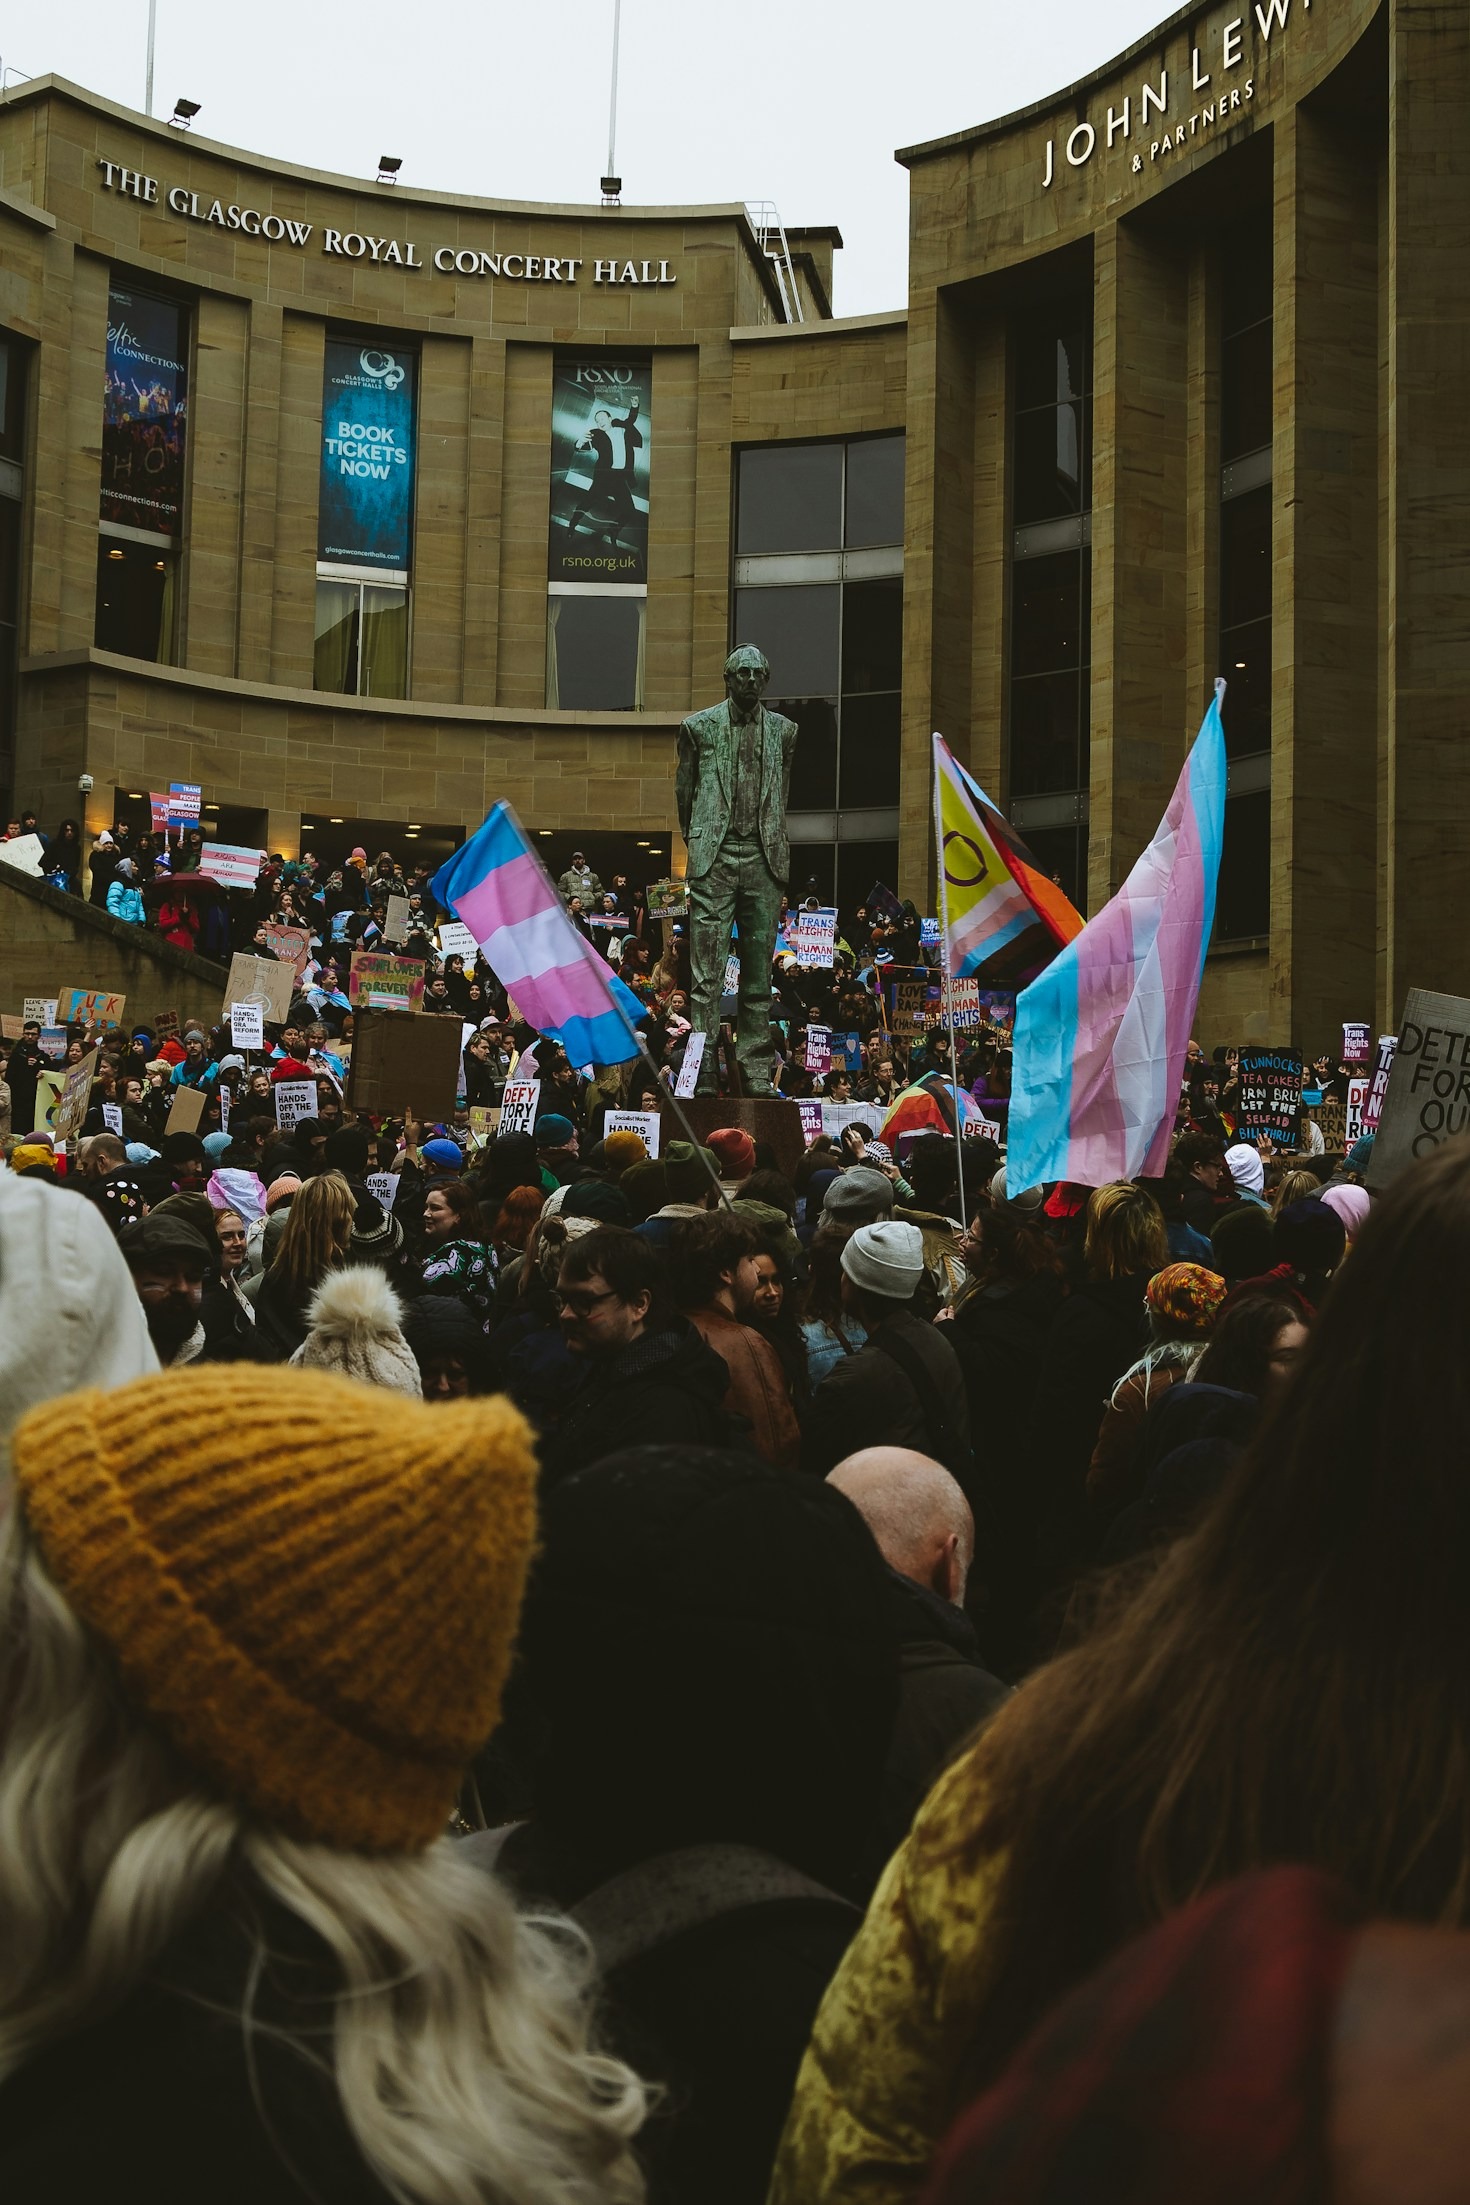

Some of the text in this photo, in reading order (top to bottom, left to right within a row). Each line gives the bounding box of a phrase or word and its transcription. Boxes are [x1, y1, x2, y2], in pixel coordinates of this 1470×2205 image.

[1042, 0, 1311, 187] JOHN LEW
[1131, 79, 1254, 173] & PARTNERS
[99, 159, 676, 283] THE GLASGOW ROYAL CONCERT HALL
[106, 321, 142, 354] eltic
[117, 346, 185, 373] CONNECTIONS
[344, 374, 383, 384] GLASGOW'S
[575, 364, 633, 384] RSNO
[331, 377, 382, 390] CONCERT HALLS
[339, 421, 394, 444] BOOK
[325, 438, 407, 464] TICKETS
[341, 459, 390, 480] NOW
[325, 545, 400, 561] glasgowconcerthalls.com
[562, 555, 636, 572] rsno.org.uk
[169, 810, 200, 818] GLASGOW
[801, 917, 834, 928] TRANS
[799, 926, 834, 937] RIGHTS
[266, 935, 305, 948] ROTECT
[274, 947, 298, 957] RANS
[797, 944, 833, 955] HUMAN
[798, 953, 833, 963] RIGHTS
[898, 983, 928, 998] LOVE
[71, 990, 119, 1014] FUCK
[897, 999, 926, 1012] RAGE
[941, 1009, 980, 1029] RGHTS
[807, 1030, 827, 1043] Trans
[1344, 1028, 1365, 1037] Trans
[807, 1042, 831, 1057] Rights
[1344, 1037, 1369, 1049] Rights
[1344, 1047, 1361, 1057] Now
[806, 1054, 823, 1068] Now
[1240, 1056, 1301, 1075] TUNNOCKS
[1241, 1073, 1300, 1089] TEA CAKES
[1410, 1063, 1470, 1104] FOR
[278, 1094, 307, 1103] HANDS
[504, 1087, 537, 1103] DEFY
[1273, 1087, 1301, 1107] BRU!
[279, 1102, 312, 1111] OFF THE
[503, 1103, 534, 1118] TORY
[799, 1107, 815, 1116] ans
[1240, 1100, 1297, 1115] LET THE
[280, 1112, 296, 1120] GRA
[1420, 1099, 1470, 1136] OU
[499, 1119, 530, 1133] RULE
[609, 1125, 646, 1134] HANDS
[964, 1122, 997, 1139] DEFY
[1238, 1127, 1260, 1140] BILL
[1263, 1127, 1296, 1147] THRU!
[376, 1189, 391, 1198] THE
